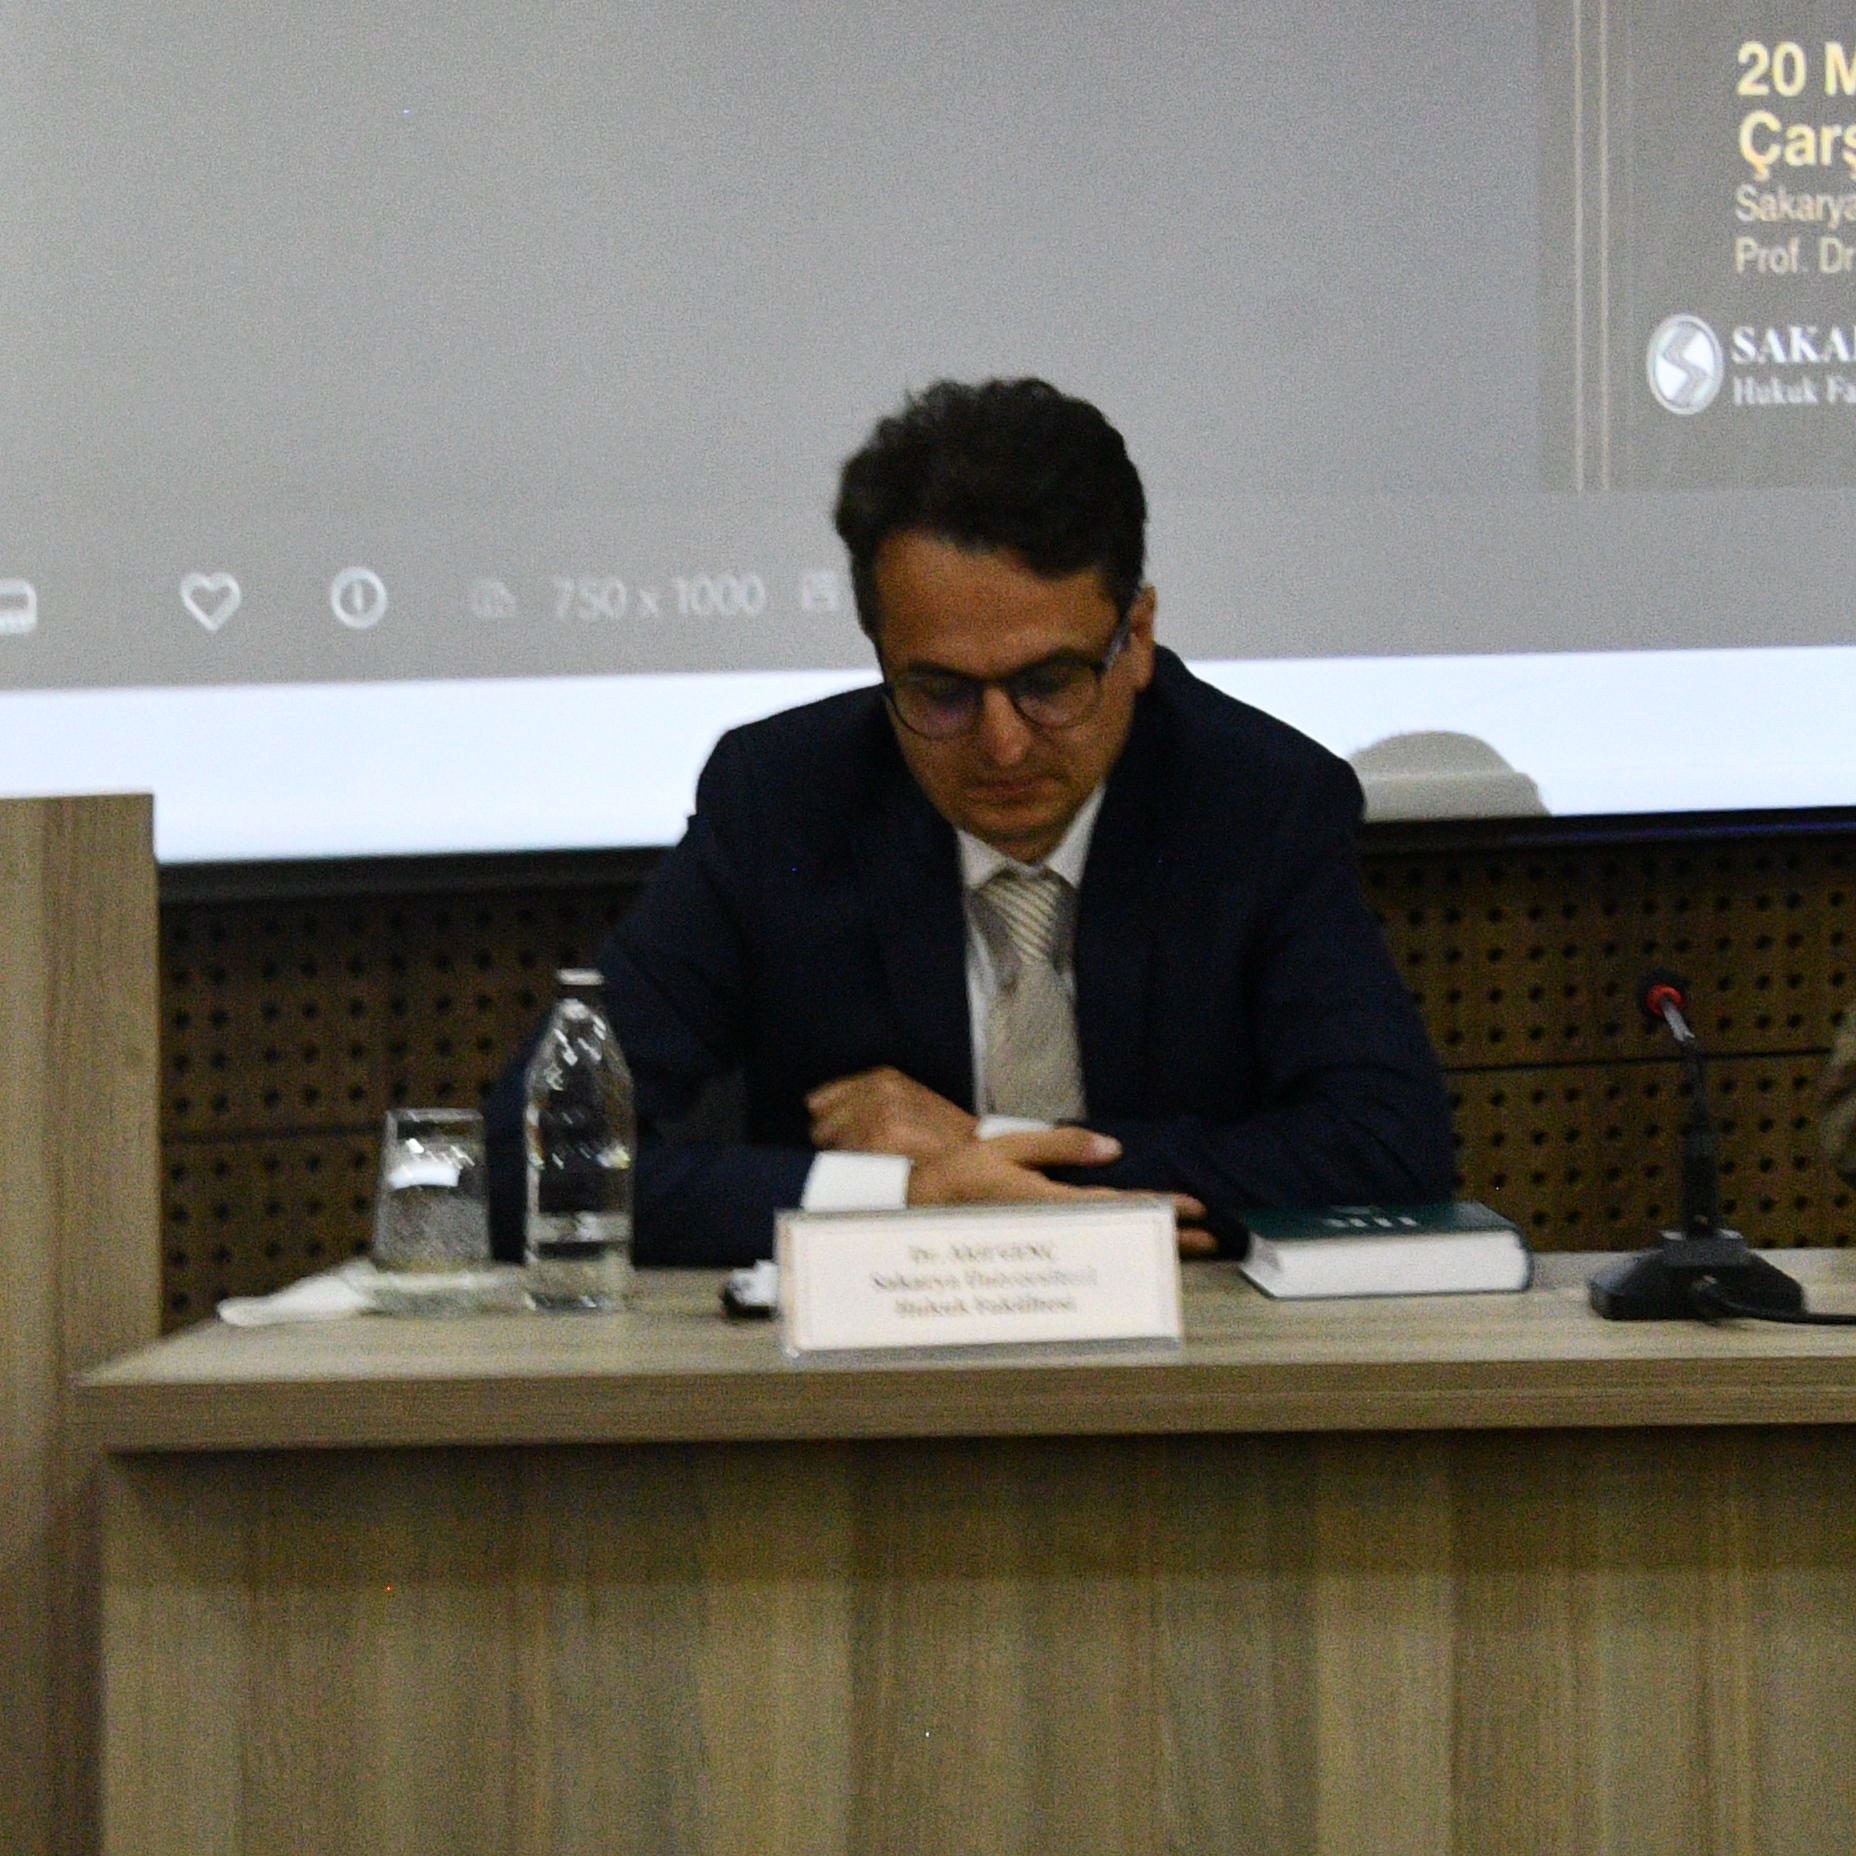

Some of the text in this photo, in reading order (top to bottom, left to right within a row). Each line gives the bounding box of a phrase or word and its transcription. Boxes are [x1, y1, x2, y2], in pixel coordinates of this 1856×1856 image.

[1736, 40, 1807, 97] 20
[551, 575, 627, 620] 750
[674, 572, 766, 618] 1000
